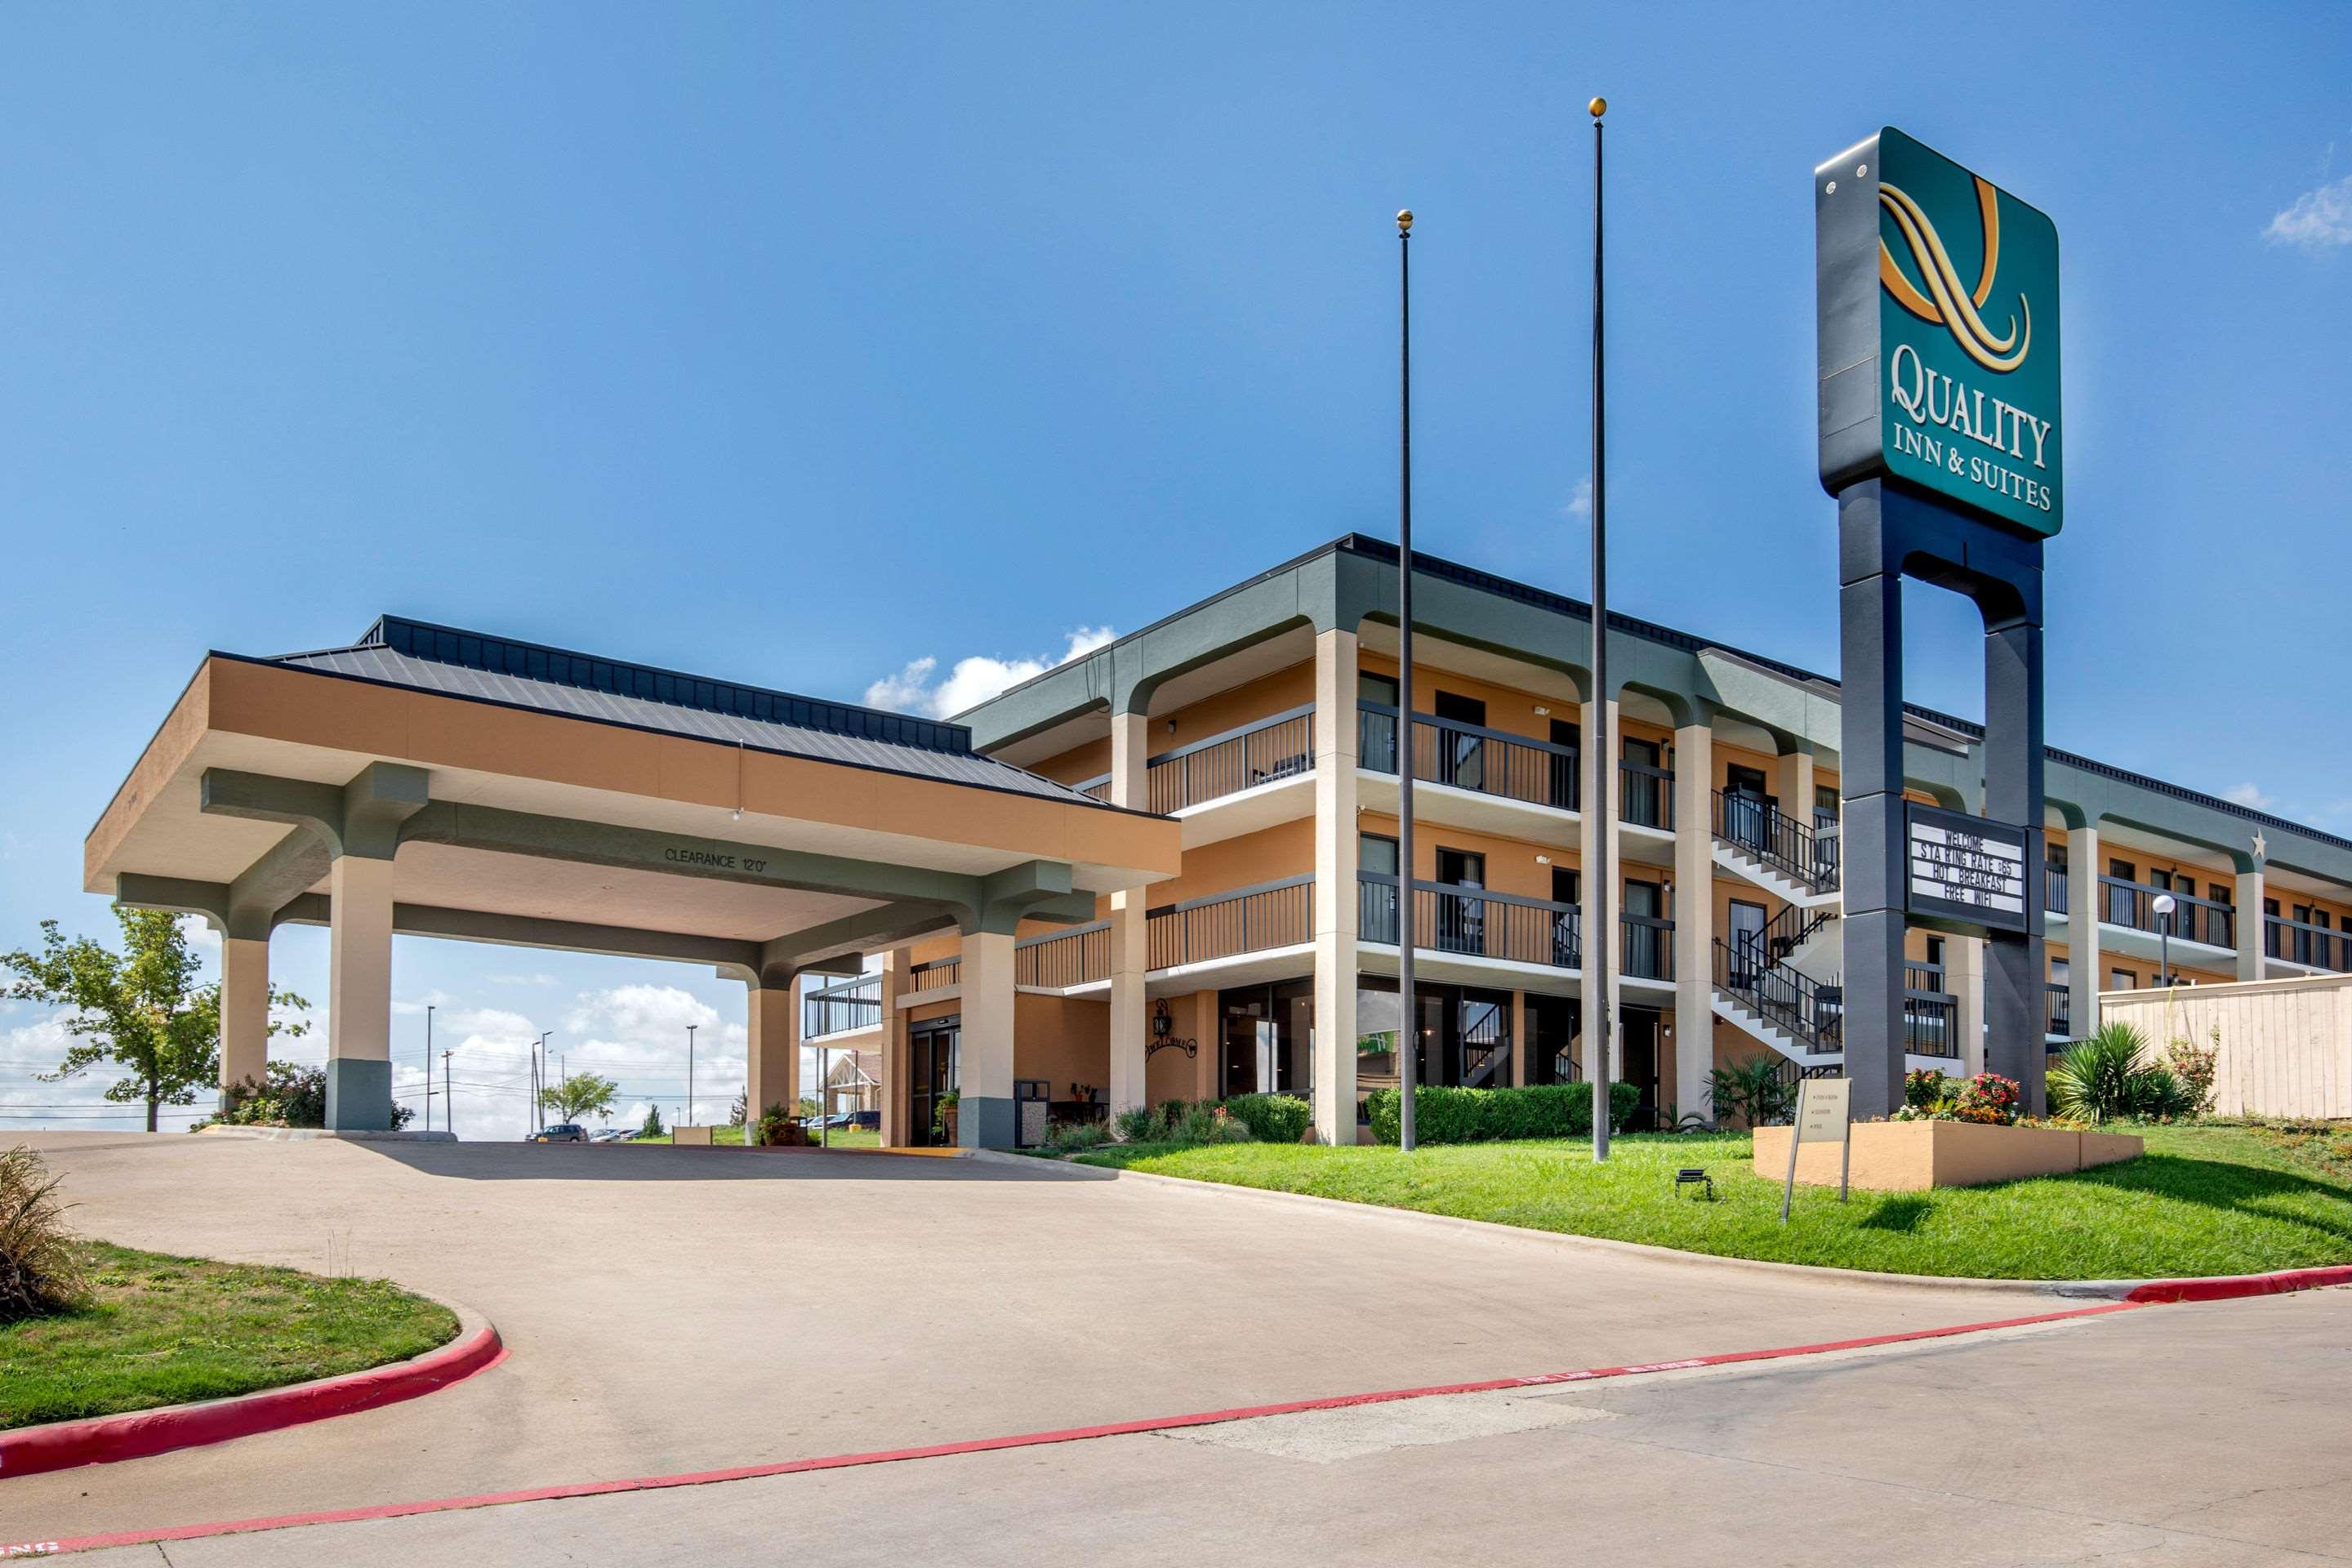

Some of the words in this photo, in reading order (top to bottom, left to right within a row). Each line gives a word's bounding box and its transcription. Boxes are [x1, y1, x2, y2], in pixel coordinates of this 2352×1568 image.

[1891, 344, 2051, 469] QUALITY
[1894, 422, 1943, 467] INN
[1948, 447, 1965, 476] &
[1971, 457, 2051, 511] SUITES
[1944, 829, 1984, 852] WELCOME
[665, 849, 736, 868] CLEARANCE
[1971, 854, 1993, 871] RATE
[1933, 863, 1950, 880] HOT
[1959, 868, 2007, 893] BREAKFAST
[1944, 884, 1965, 902] FREE
[1974, 889, 1992, 908] WIFI
